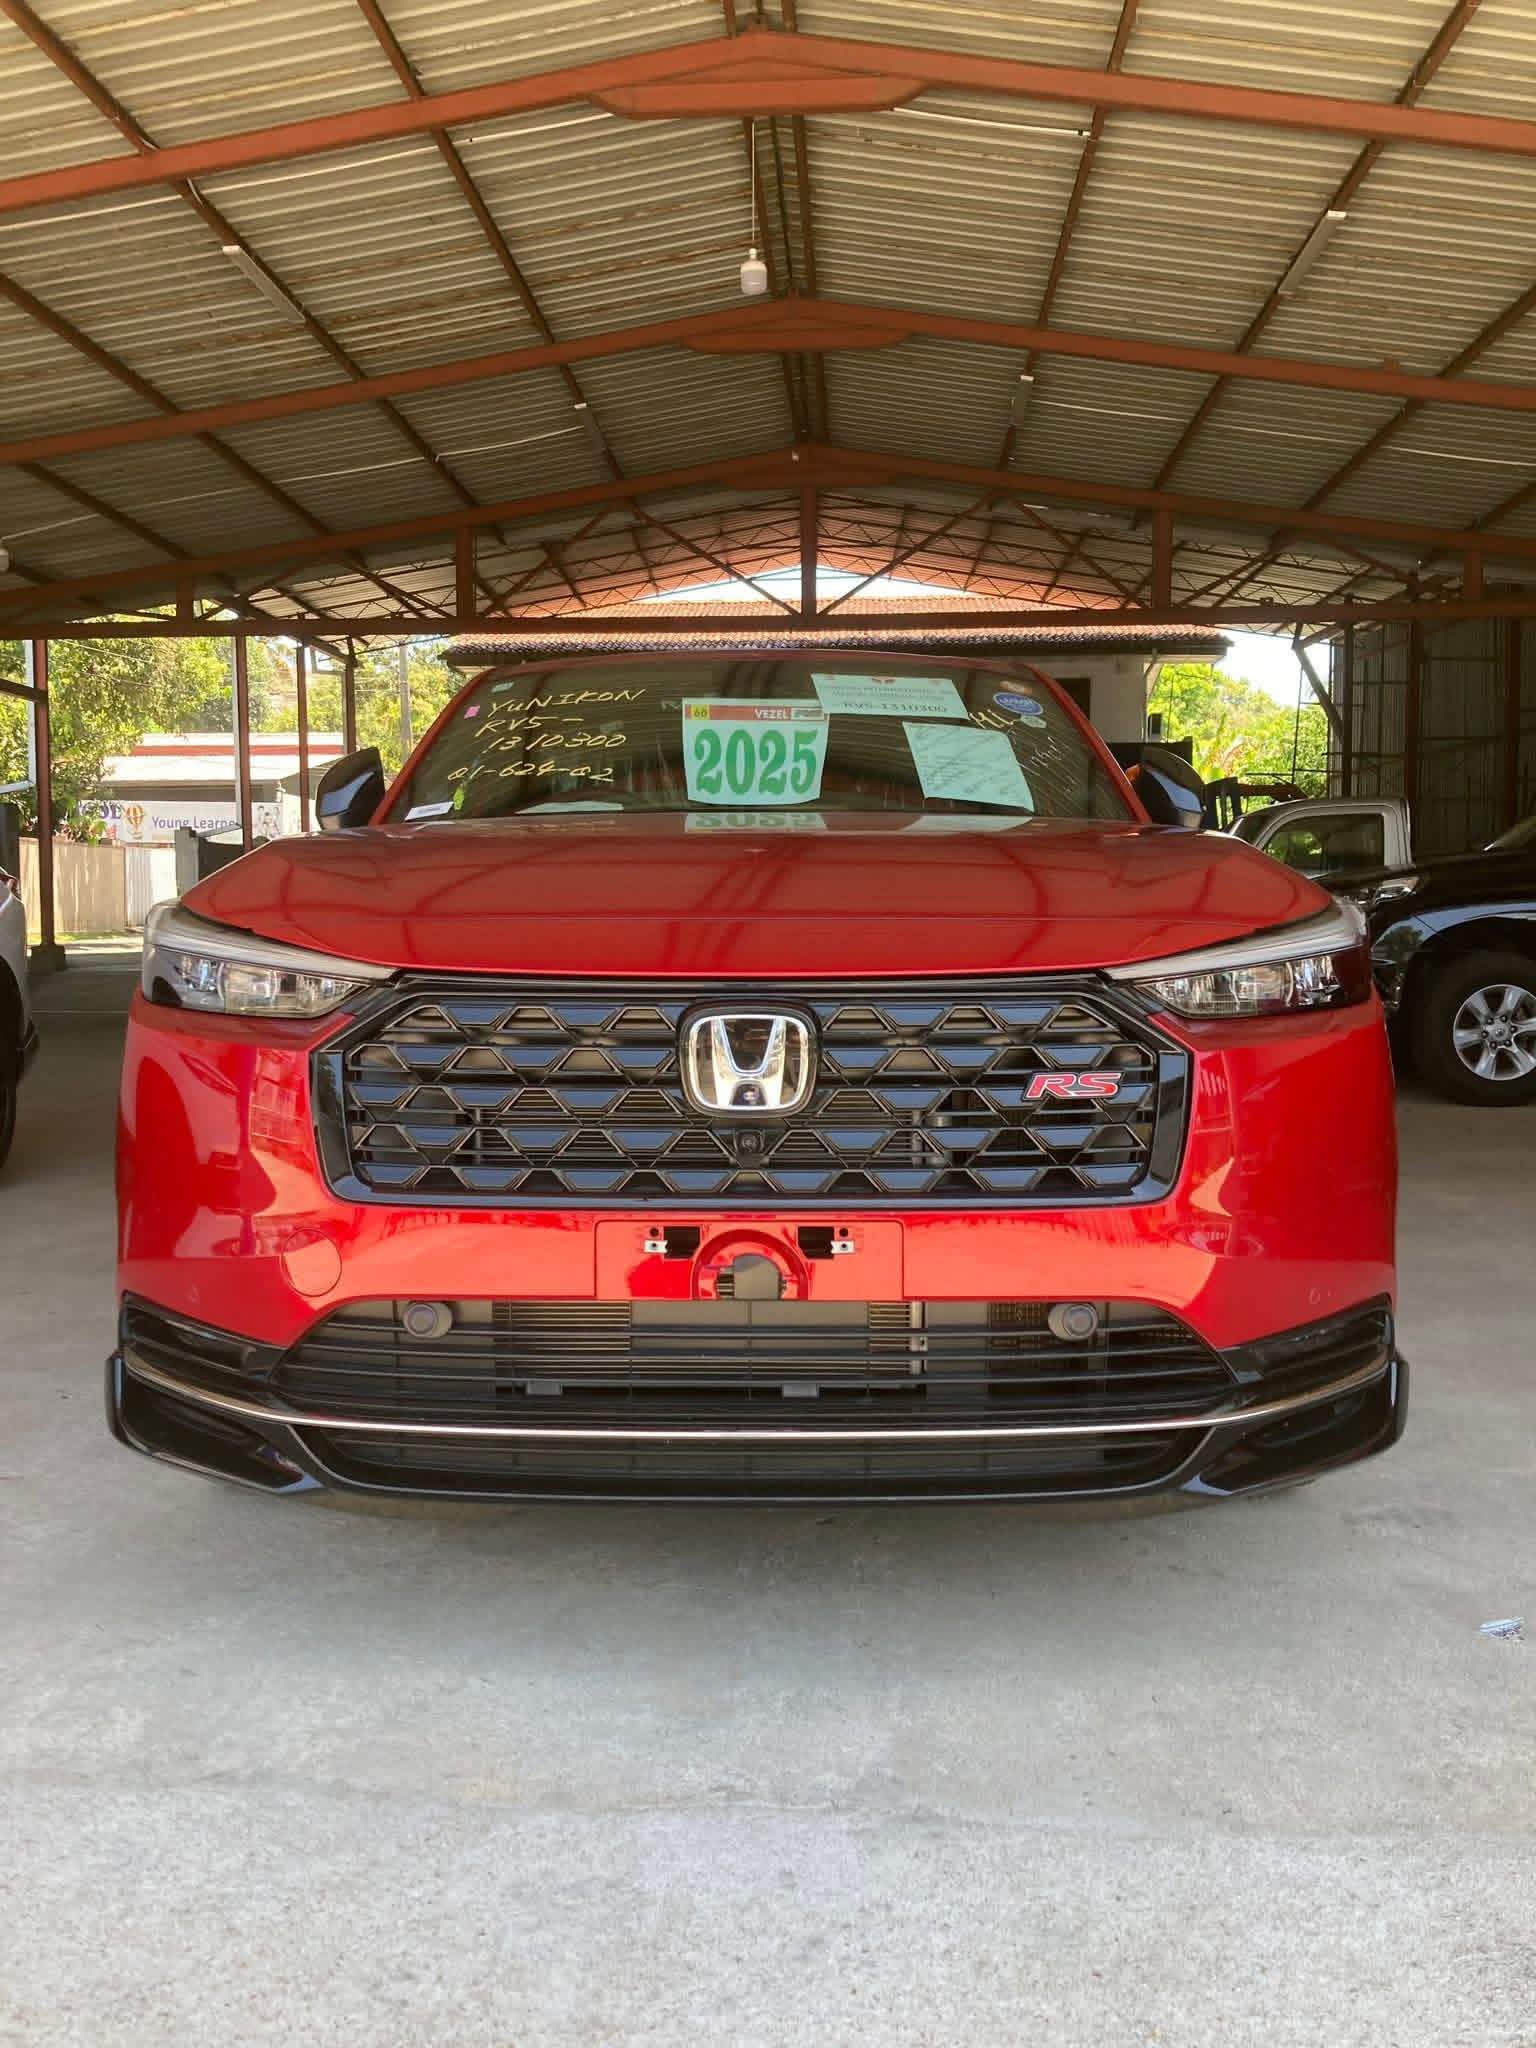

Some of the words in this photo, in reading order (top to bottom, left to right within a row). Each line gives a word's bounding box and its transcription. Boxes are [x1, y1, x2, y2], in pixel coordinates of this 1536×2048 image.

[754, 708, 788, 720] VEZEL
[694, 729, 818, 795] 2025
[1026, 1072, 1121, 1098] RS
